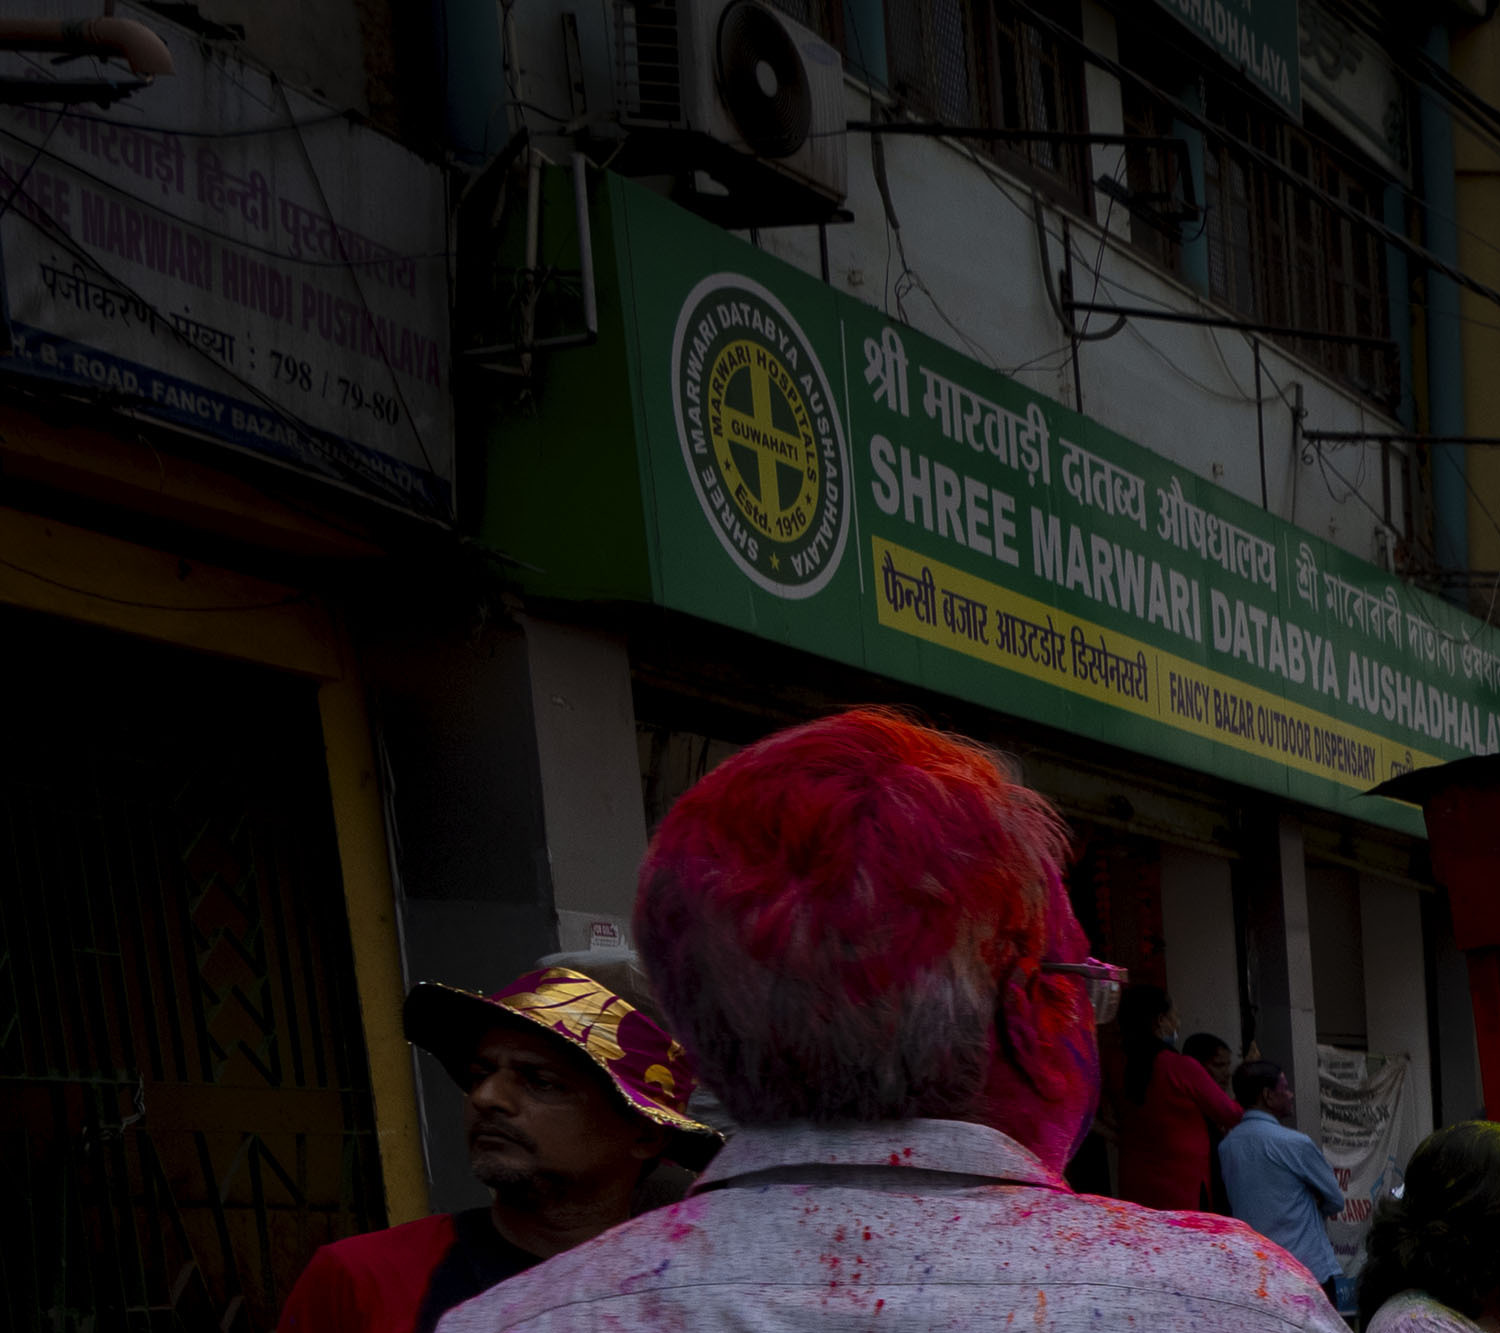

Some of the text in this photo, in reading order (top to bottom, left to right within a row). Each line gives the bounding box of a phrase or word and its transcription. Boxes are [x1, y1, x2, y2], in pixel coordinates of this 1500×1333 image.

[81, 190, 212, 291] MARWARI
[222, 247, 293, 324] HINDI
[198, 147, 270, 233] हिन्दी
[280, 197, 417, 298] पुस्तकालय
[40, 255, 158, 336] पंजीकरण
[270, 350, 313, 394] 798
[337, 377, 400, 427] 79-80
[40, 342, 67, 369] B.
[152, 380, 225, 422] FANCY
[712, 345, 818, 484] MARWARI HOSPITALS
[685, 300, 841, 578] SHREE MARWARI DATABYA AUSHADHALAYA
[731, 419, 799, 462] GUWAHATI
[733, 483, 807, 539] Estd. 1916
[864, 326, 910, 418] श्री
[919, 365, 1052, 489] मारवाड़ी
[1157, 475, 1278, 592] औषधालय
[870, 433, 1020, 567] SHREE
[1030, 505, 1202, 643] MARWARI
[1210, 587, 1341, 699] DATABYA
[882, 551, 937, 626] फैन्सी
[941, 588, 989, 646] बजार
[995, 613, 1067, 674] आउटडोर
[1070, 625, 1149, 703] डिस्पेनसरी
[1168, 670, 1211, 724] FANCY
[1212, 687, 1256, 742] BAZAR
[1257, 704, 1312, 758] OUTDOOR
[1313, 728, 1378, 782] DISPENSARY
